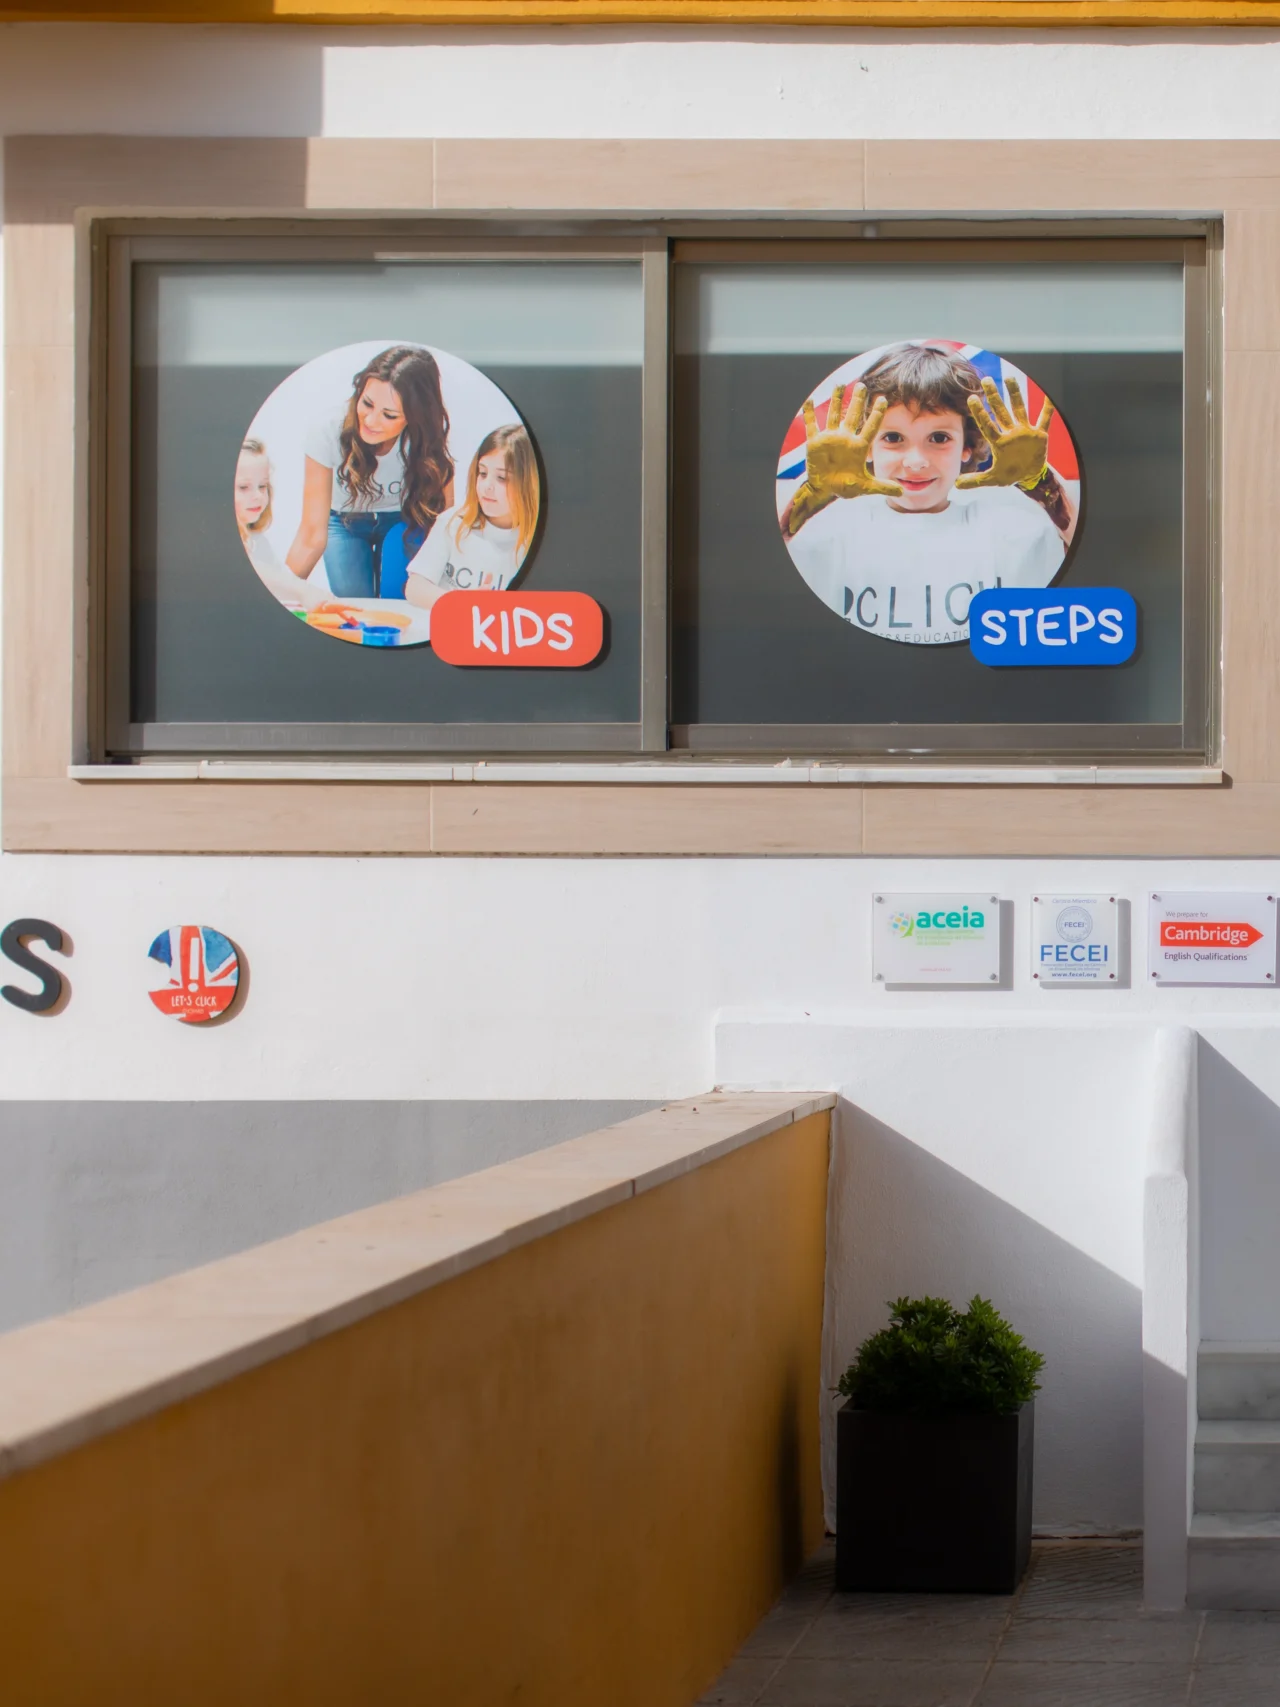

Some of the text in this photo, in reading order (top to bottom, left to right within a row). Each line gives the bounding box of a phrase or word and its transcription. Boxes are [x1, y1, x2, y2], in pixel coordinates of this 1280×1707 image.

[856, 576, 1002, 629] CLIC
[470, 604, 575, 656] KIDS
[980, 603, 1124, 647] STEPS
[916, 905, 985, 928] aceia
[1176, 911, 1199, 919] prepare
[1164, 925, 1249, 945] Cambridge
[1040, 944, 1108, 962] FECEI
[1164, 952, 1248, 962] English Qualifications
[1, 918, 64, 1012] S
[171, 995, 217, 1007] LET'S CLICK
